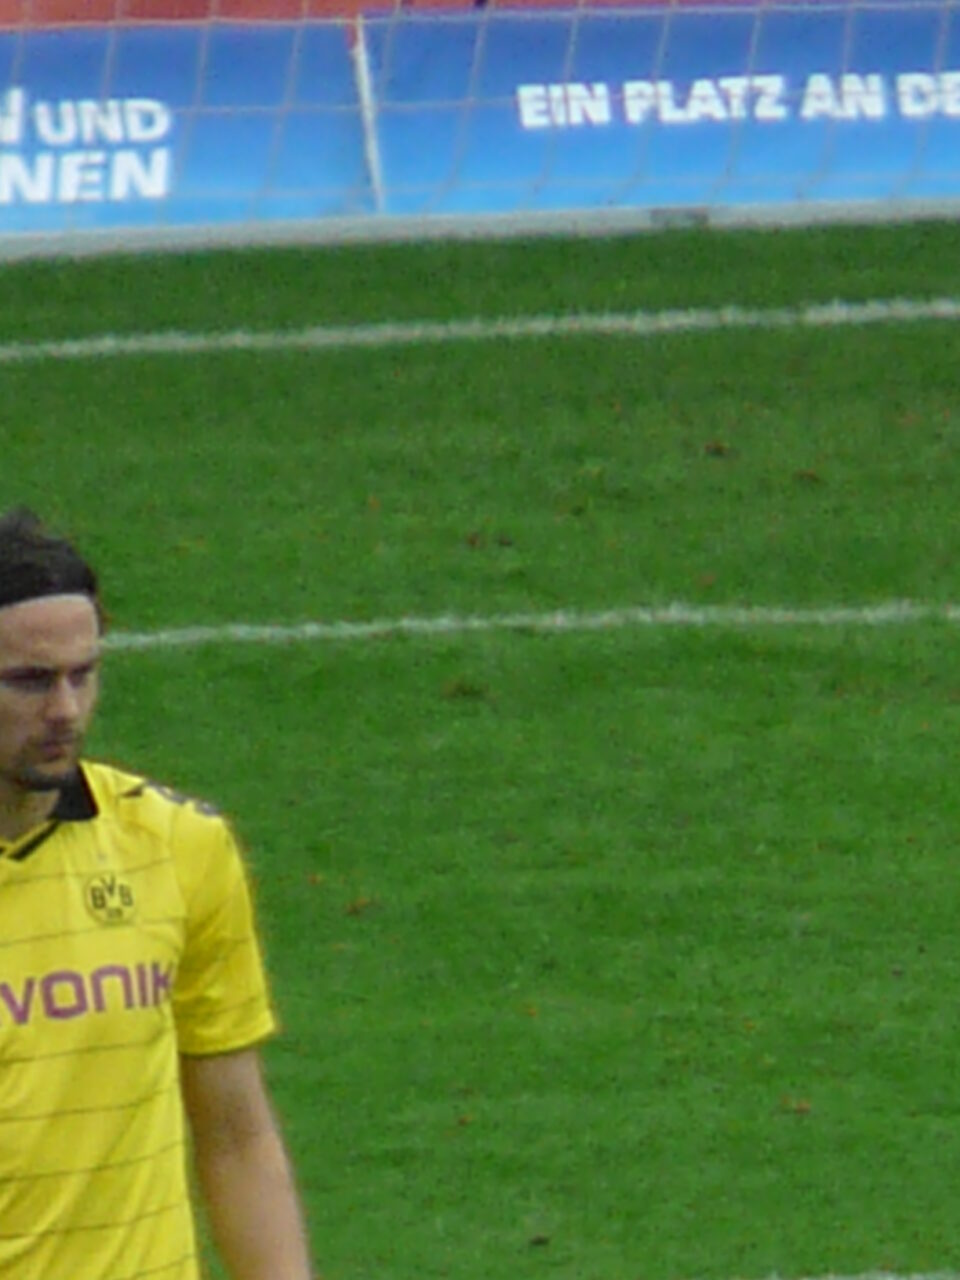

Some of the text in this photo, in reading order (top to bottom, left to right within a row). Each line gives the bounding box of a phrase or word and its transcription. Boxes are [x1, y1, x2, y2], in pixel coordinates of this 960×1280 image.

[34, 98, 172, 146] UND
[516, 83, 611, 128] EIN
[623, 75, 786, 123] PLATZ
[800, 73, 883, 120] AN
